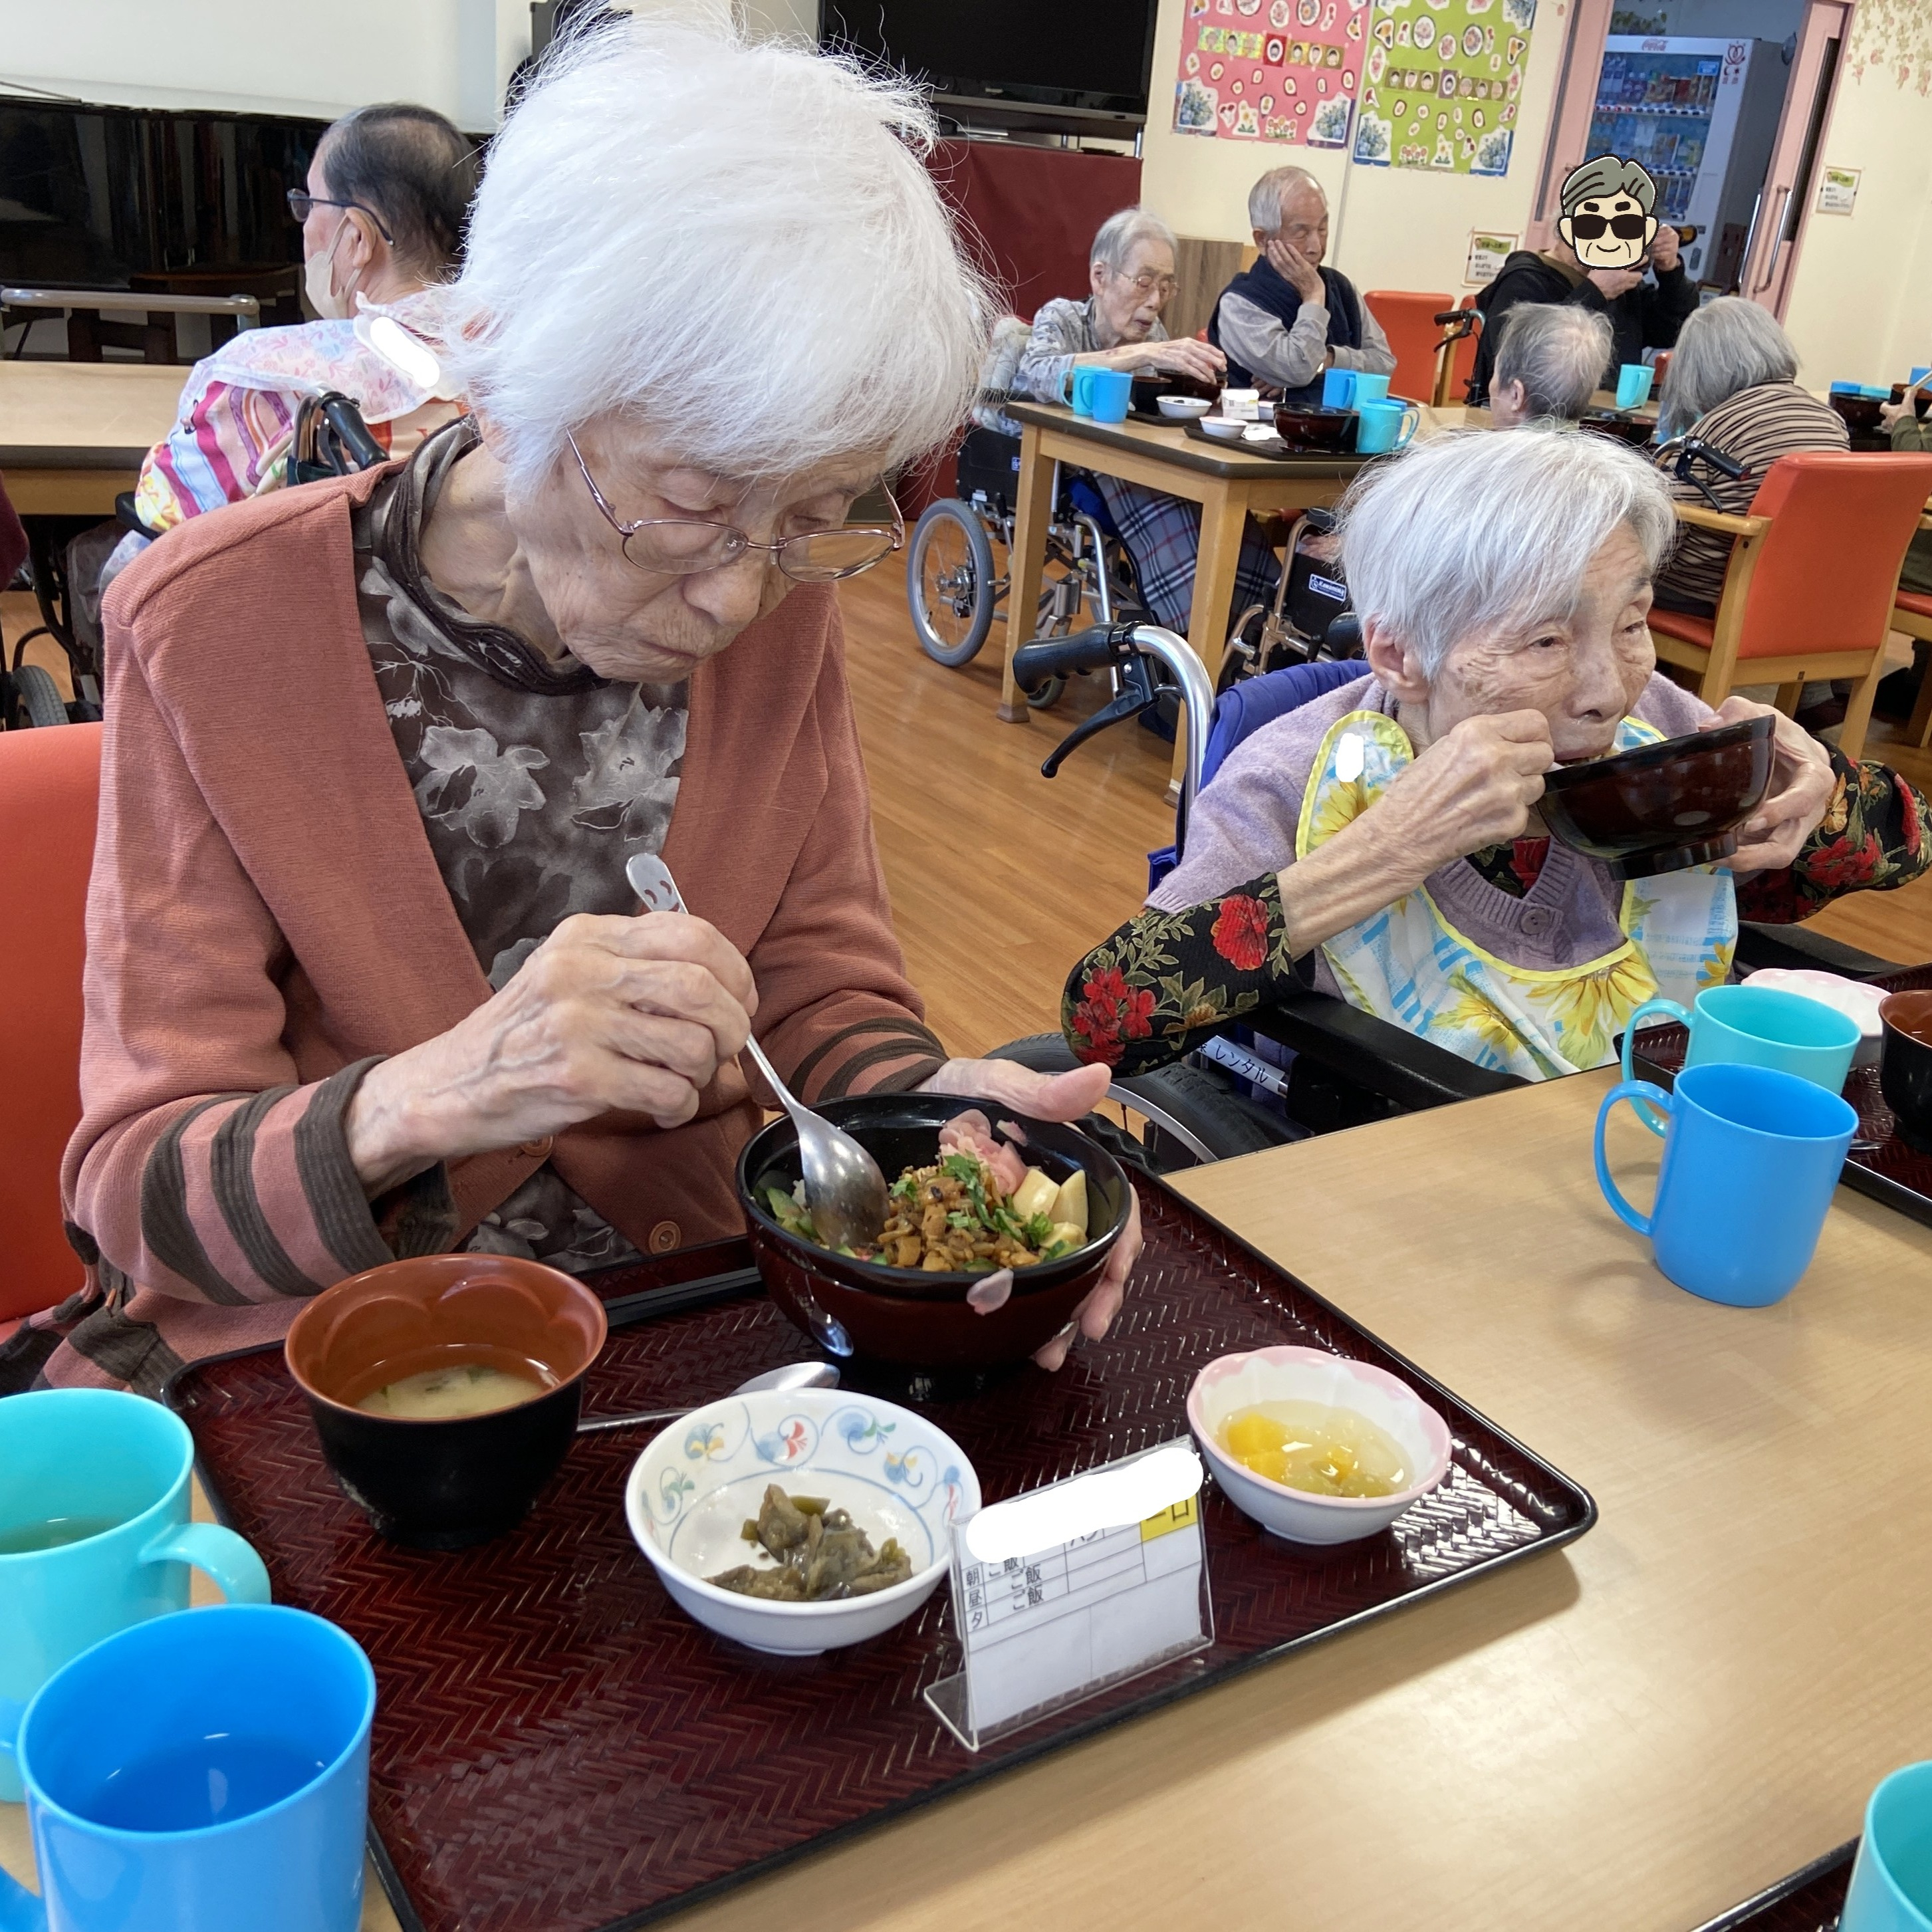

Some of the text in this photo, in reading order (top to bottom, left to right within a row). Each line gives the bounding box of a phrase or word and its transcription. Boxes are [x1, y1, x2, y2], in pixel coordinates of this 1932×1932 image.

[1216, 1045, 1268, 1083] レンタル
[966, 1568, 980, 1586] 朝
[969, 1564, 1041, 1608] 昼 ご飯
[1013, 1584, 1044, 1610] ご飯
